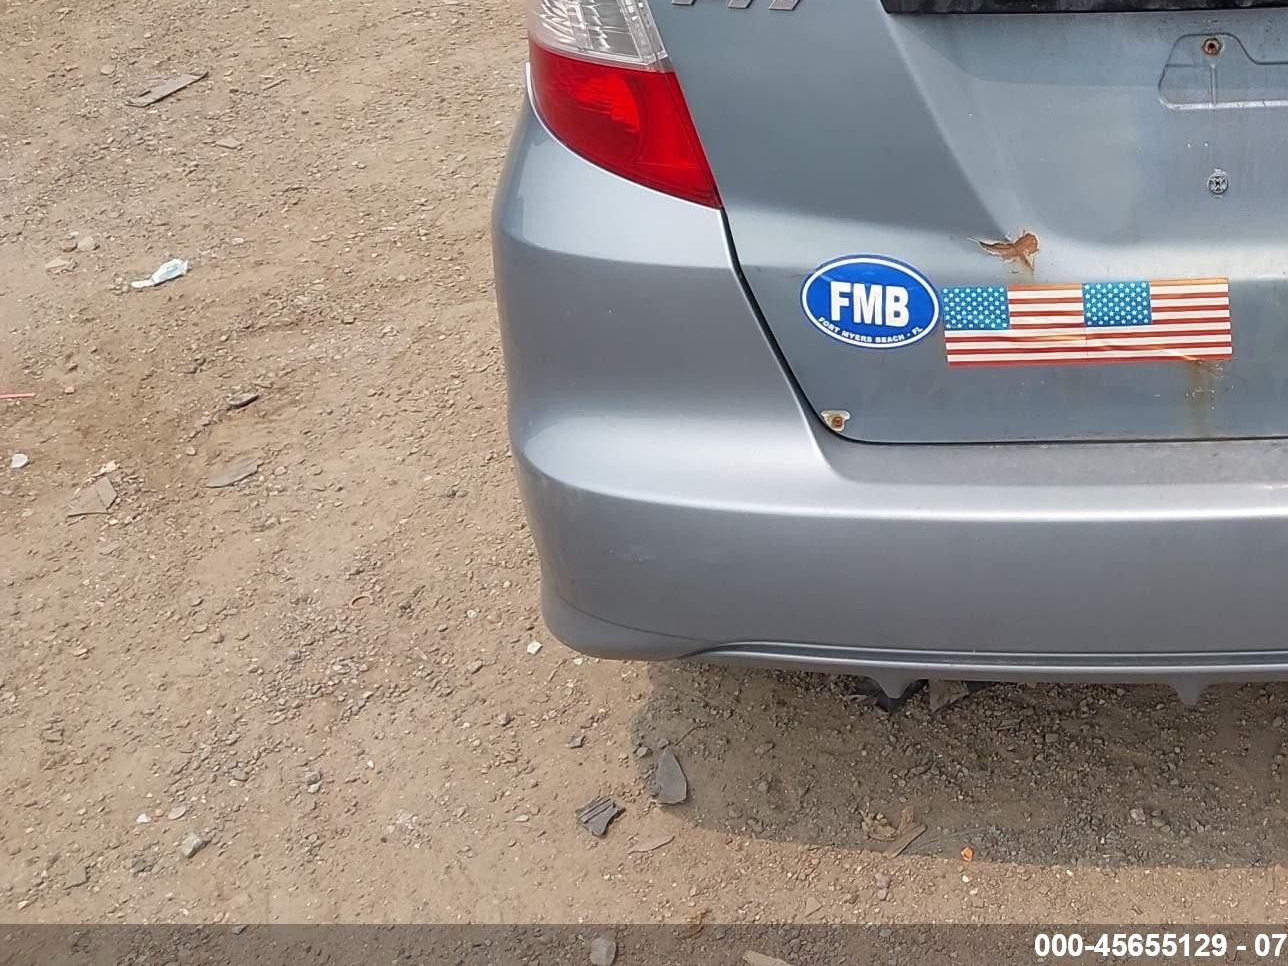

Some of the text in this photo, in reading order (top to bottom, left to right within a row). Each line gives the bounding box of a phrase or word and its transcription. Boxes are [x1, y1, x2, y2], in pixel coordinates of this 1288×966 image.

[830, 281, 909, 327] FMB
[818, 317, 924, 344] FORT MYERS BEACH FL
